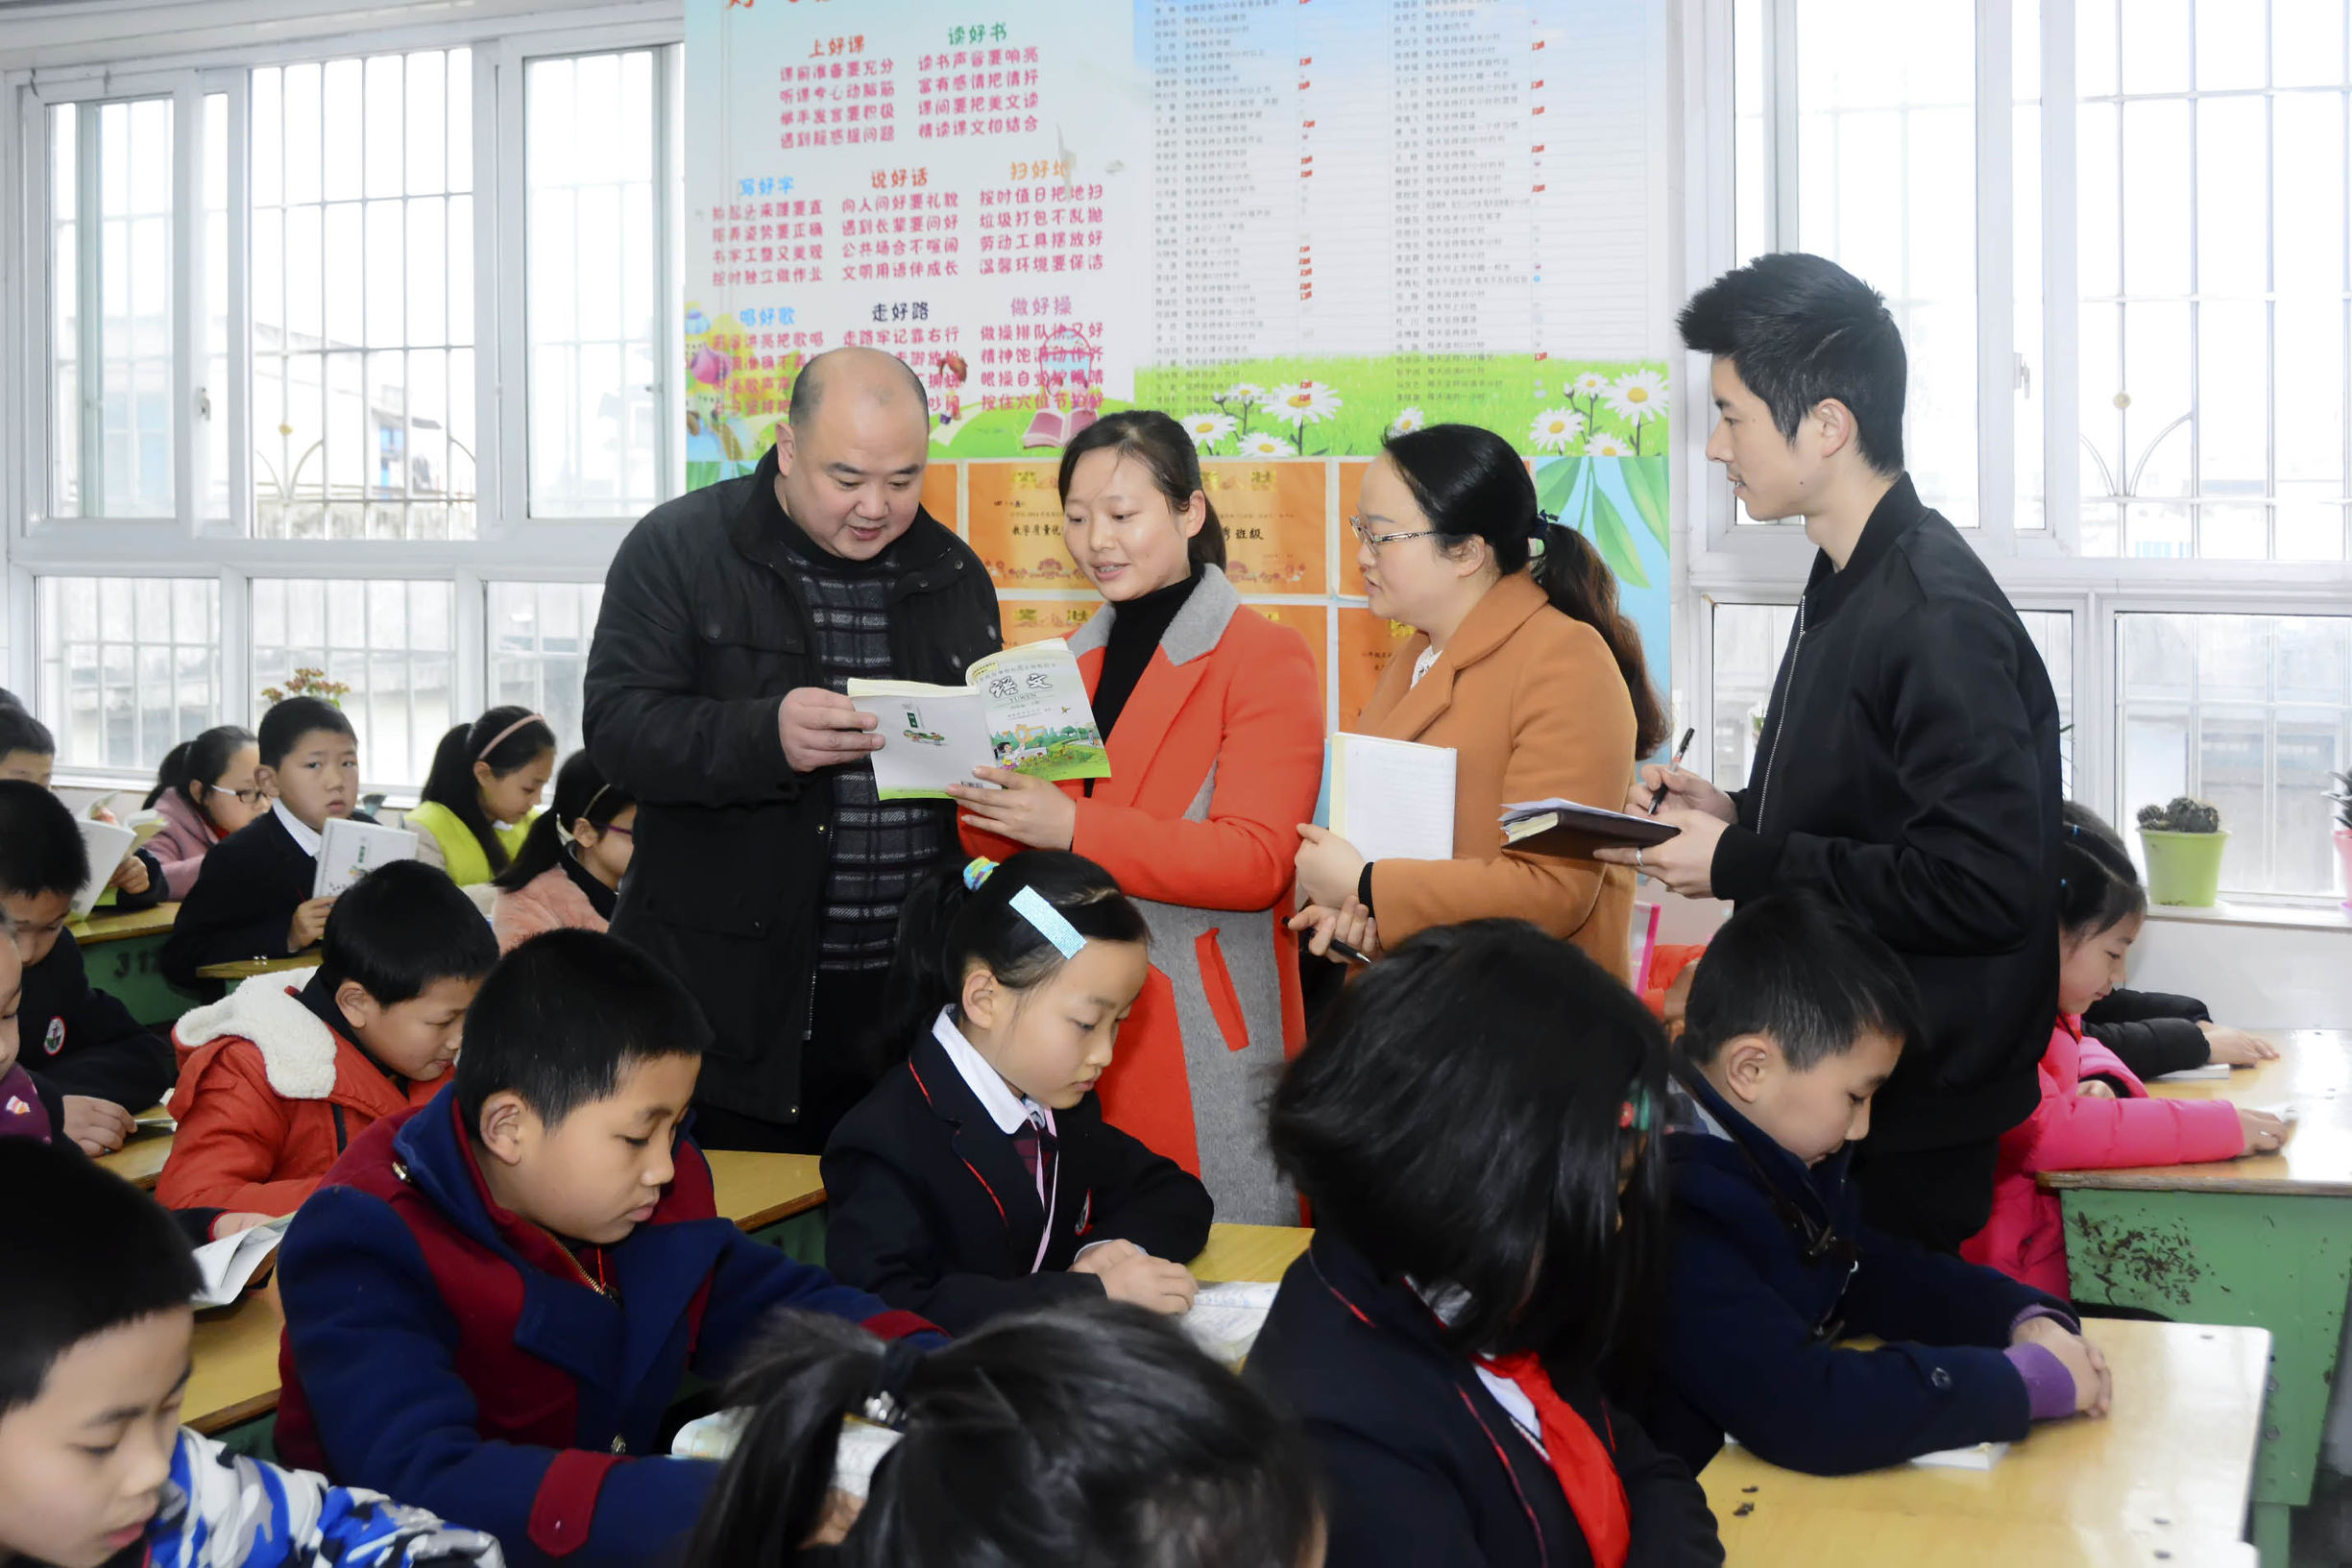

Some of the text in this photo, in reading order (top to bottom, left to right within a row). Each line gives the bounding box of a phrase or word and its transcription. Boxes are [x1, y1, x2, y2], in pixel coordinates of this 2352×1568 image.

[948, 22, 1007, 45] 读好书
[809, 35, 864, 58] 上好课
[739, 176, 794, 197] 写好字
[871, 166, 929, 189] 说好话
[872, 302, 929, 322] 走好路
[1010, 295, 1072, 316] 做好操
[989, 673, 1054, 699] 语文
